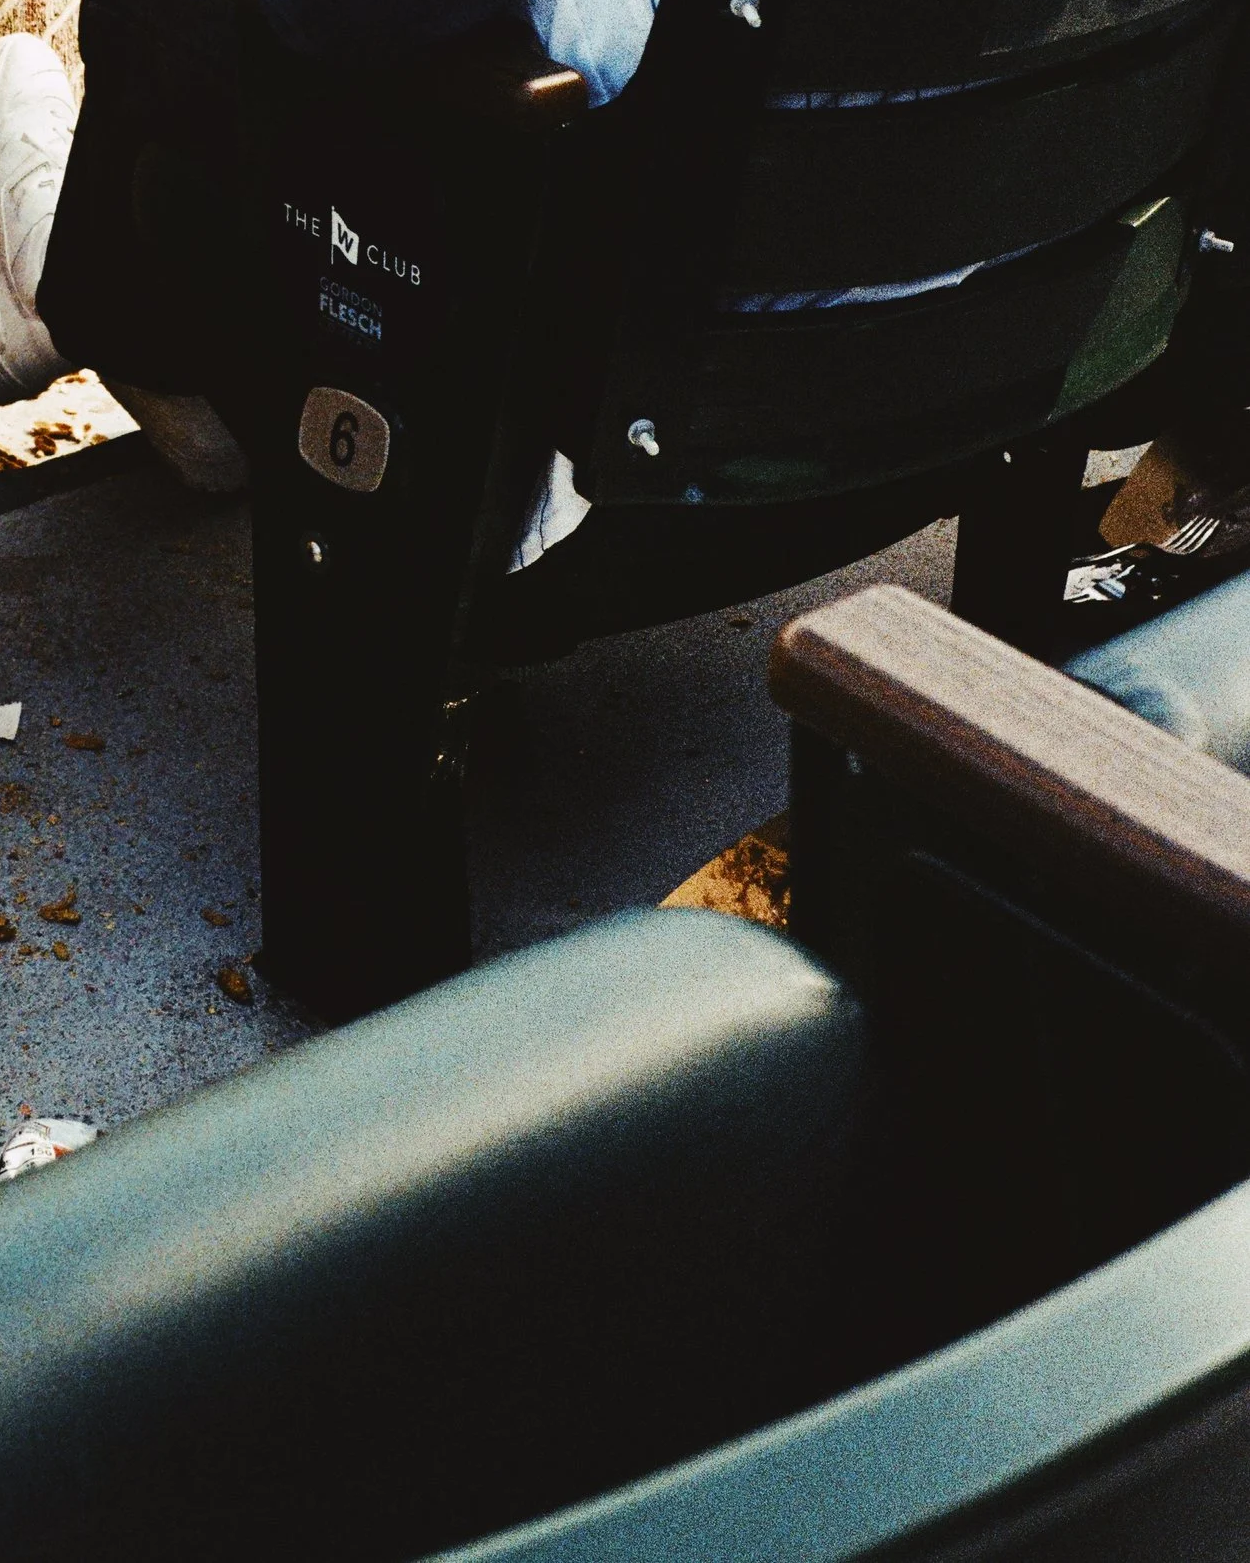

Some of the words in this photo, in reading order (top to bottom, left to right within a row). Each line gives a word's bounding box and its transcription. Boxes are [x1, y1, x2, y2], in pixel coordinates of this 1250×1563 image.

[283, 202, 321, 238] THE
[336, 221, 355, 256] W
[365, 243, 422, 286] CLUB
[319, 275, 383, 320] GORDON
[319, 293, 382, 341] FLESCH
[328, 411, 360, 468] 6
